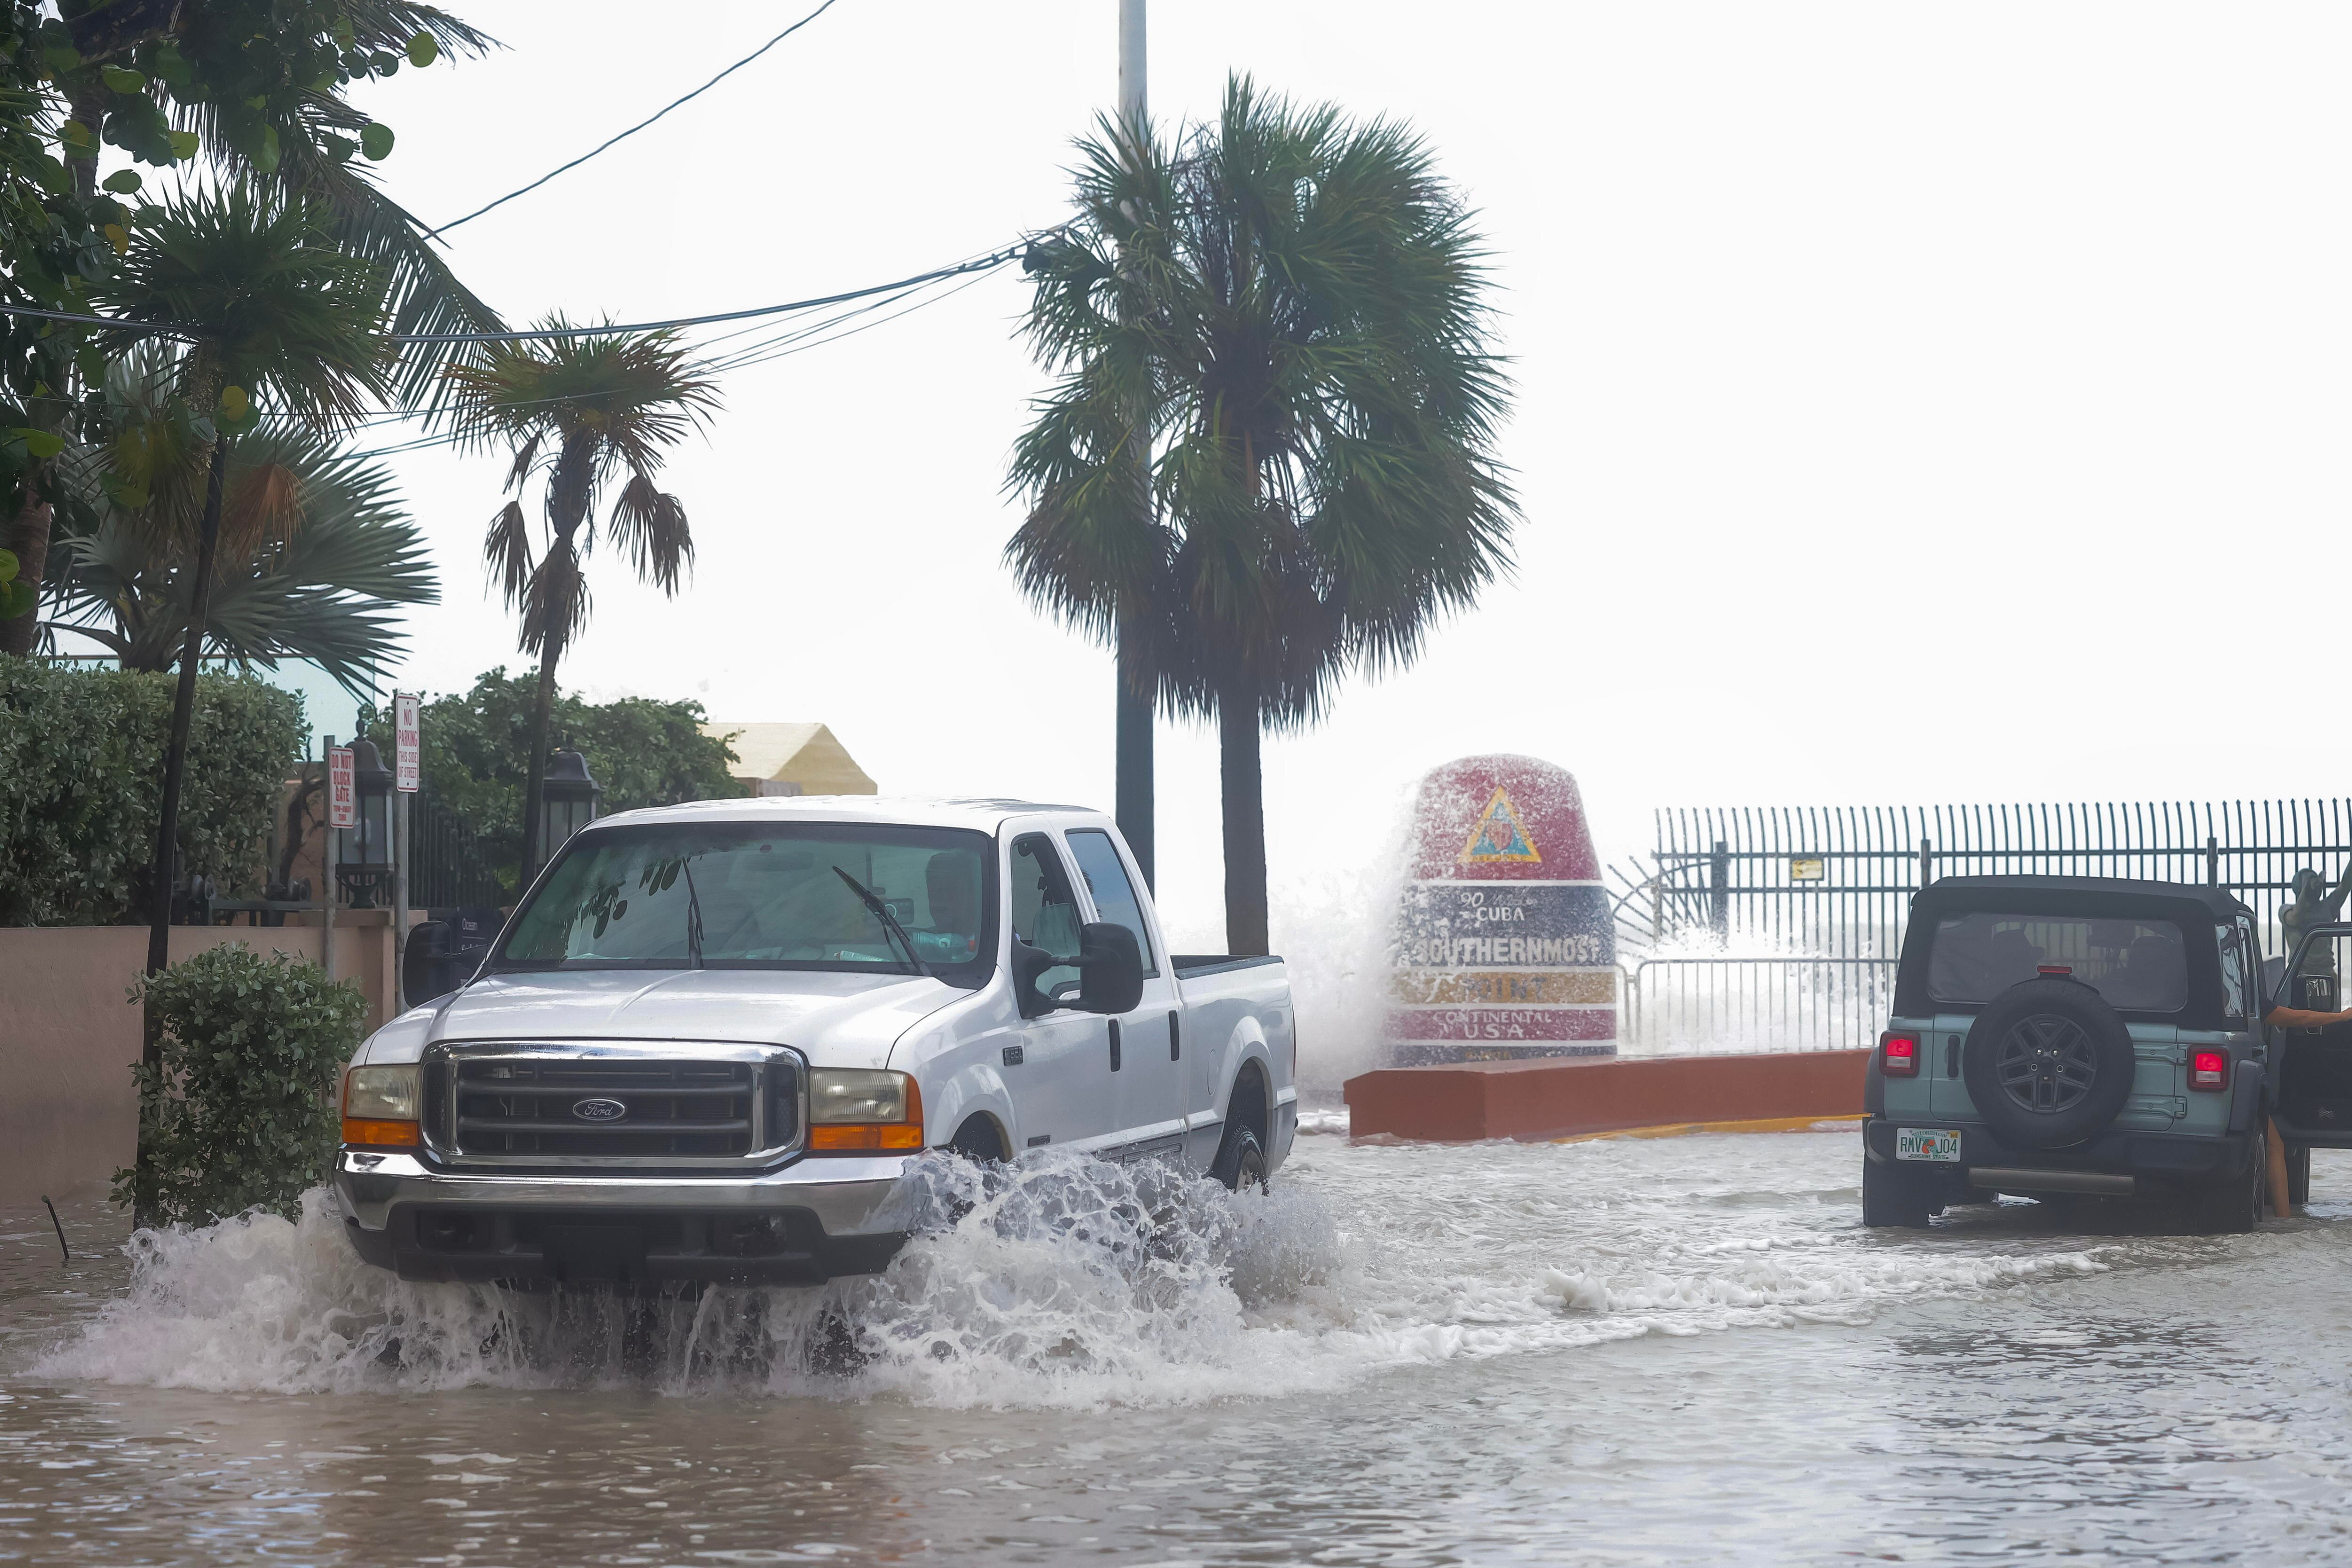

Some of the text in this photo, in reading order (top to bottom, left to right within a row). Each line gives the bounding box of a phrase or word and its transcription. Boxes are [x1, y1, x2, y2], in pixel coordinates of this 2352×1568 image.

[404, 709, 412, 726] NO
[398, 729, 418, 747] PARKING
[332, 753, 352, 770] DO NOT
[398, 751, 417, 764] THIS SIDE
[333, 770, 351, 786] BLOCK
[398, 766, 417, 779] OF STREET
[335, 786, 350, 802] GATE
[1460, 892, 1484, 907] 90
[1476, 907, 1525, 922] CUBA
[1416, 936, 1600, 963] SOUTHERNMOST
[1463, 977, 1548, 1002] POINT
[1432, 1011, 1552, 1024] CONTINENTAL
[584, 1102, 613, 1116] Ford
[1900, 1137, 1922, 1152] RMV
